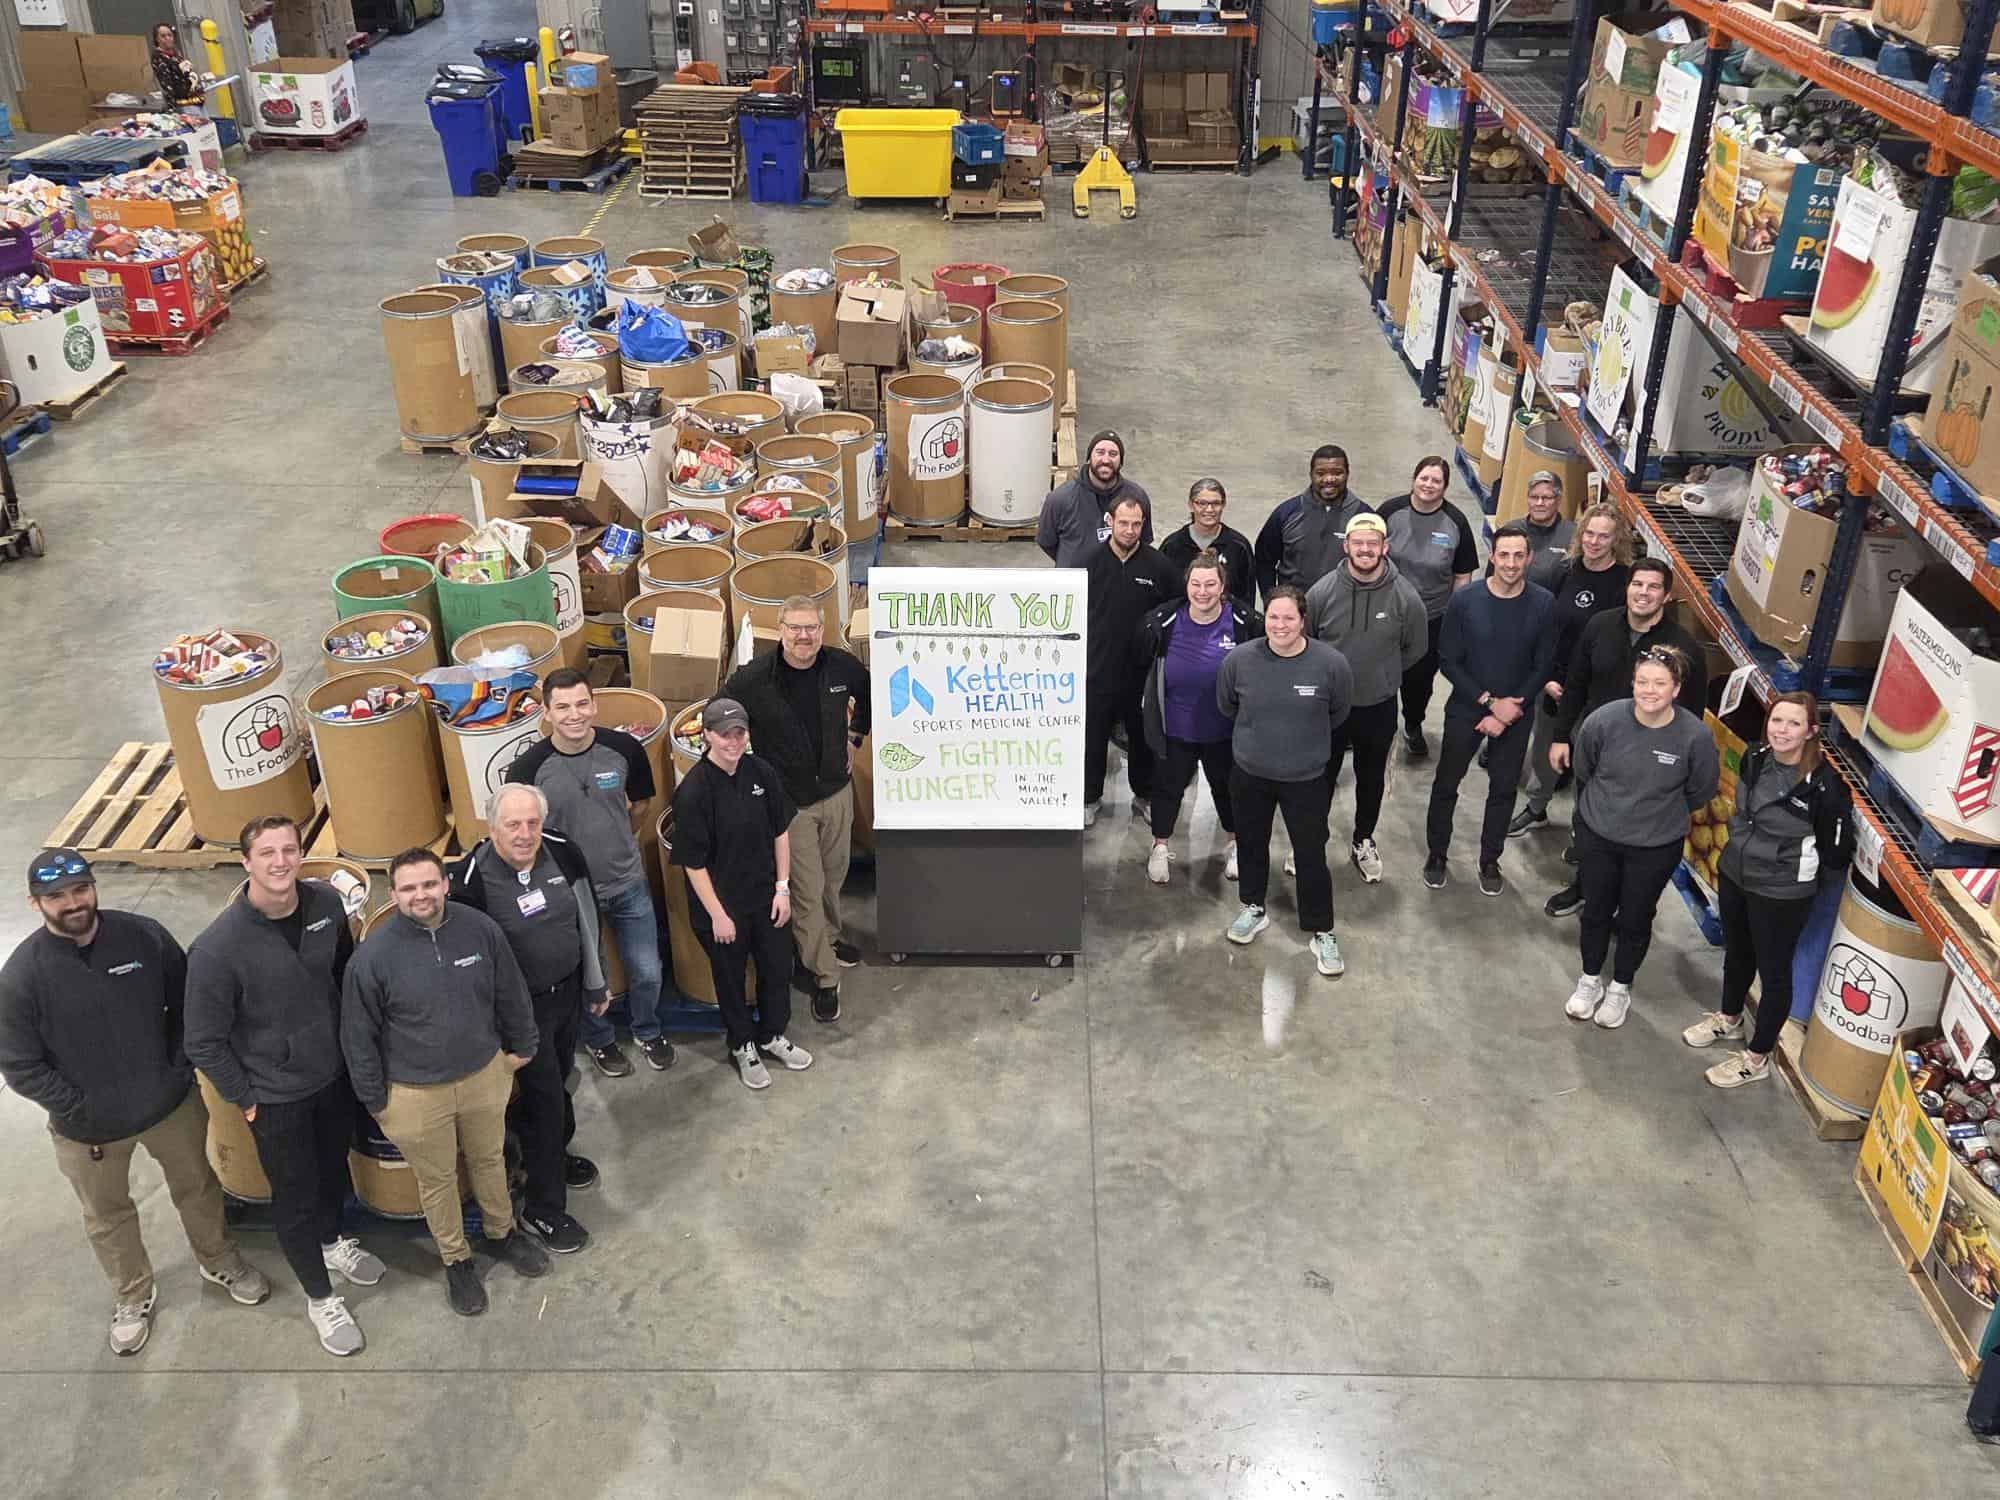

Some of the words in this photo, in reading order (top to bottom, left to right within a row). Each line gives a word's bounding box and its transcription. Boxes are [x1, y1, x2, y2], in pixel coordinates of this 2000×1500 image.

[919, 464, 936, 473] The
[878, 591, 996, 629] THANK
[1010, 592, 1074, 632] YOU
[1907, 618, 1963, 677] WATERMELONS
[945, 663, 1075, 704] Kettering
[965, 692, 1045, 713] HEALTH
[912, 718, 963, 735] SPORTS
[971, 717, 1032, 730] MEDICINE
[1038, 714, 1081, 727] CENTER
[884, 749, 908, 764] FOR
[938, 738, 1064, 769] FIGHTING
[224, 766, 257, 781] The
[884, 772, 1001, 802] HUNGER
[1014, 773, 1027, 784] IN
[1037, 773, 1057, 784] THE
[1018, 785, 1054, 793] MIAMI
[1828, 1006, 1897, 1046] Foodba
[1875, 1105, 1932, 1223] POTATOES
